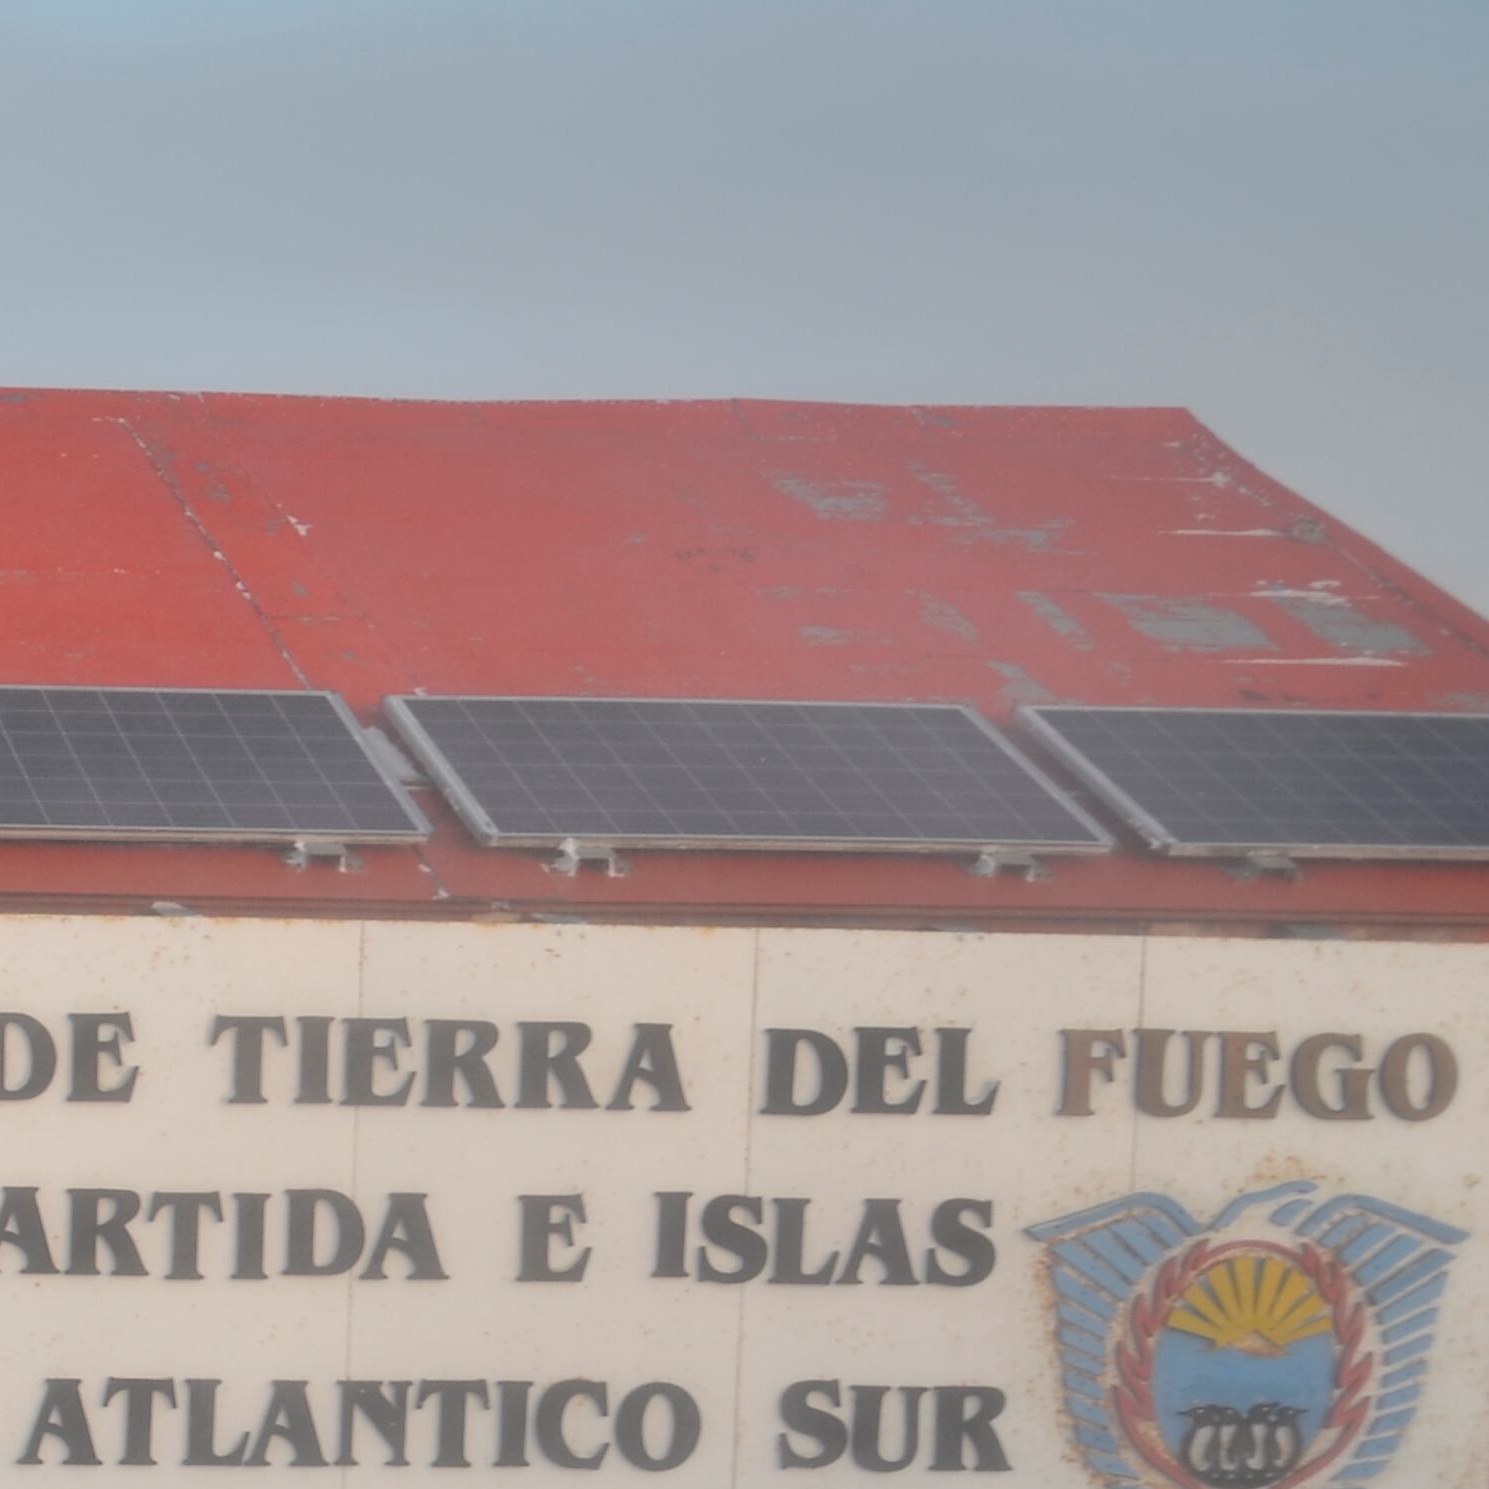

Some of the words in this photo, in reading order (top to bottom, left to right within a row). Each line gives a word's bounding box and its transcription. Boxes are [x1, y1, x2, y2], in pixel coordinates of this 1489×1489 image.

[209, 1014, 692, 1113] TIERRA
[758, 1026, 1000, 1117] DEL
[1053, 1026, 1459, 1123] FUEGO
[514, 1193, 593, 1284] E
[650, 1191, 997, 1288] ISLAS
[15, 1376, 702, 1473] ATLANTICO
[778, 1379, 1013, 1474] SUR
